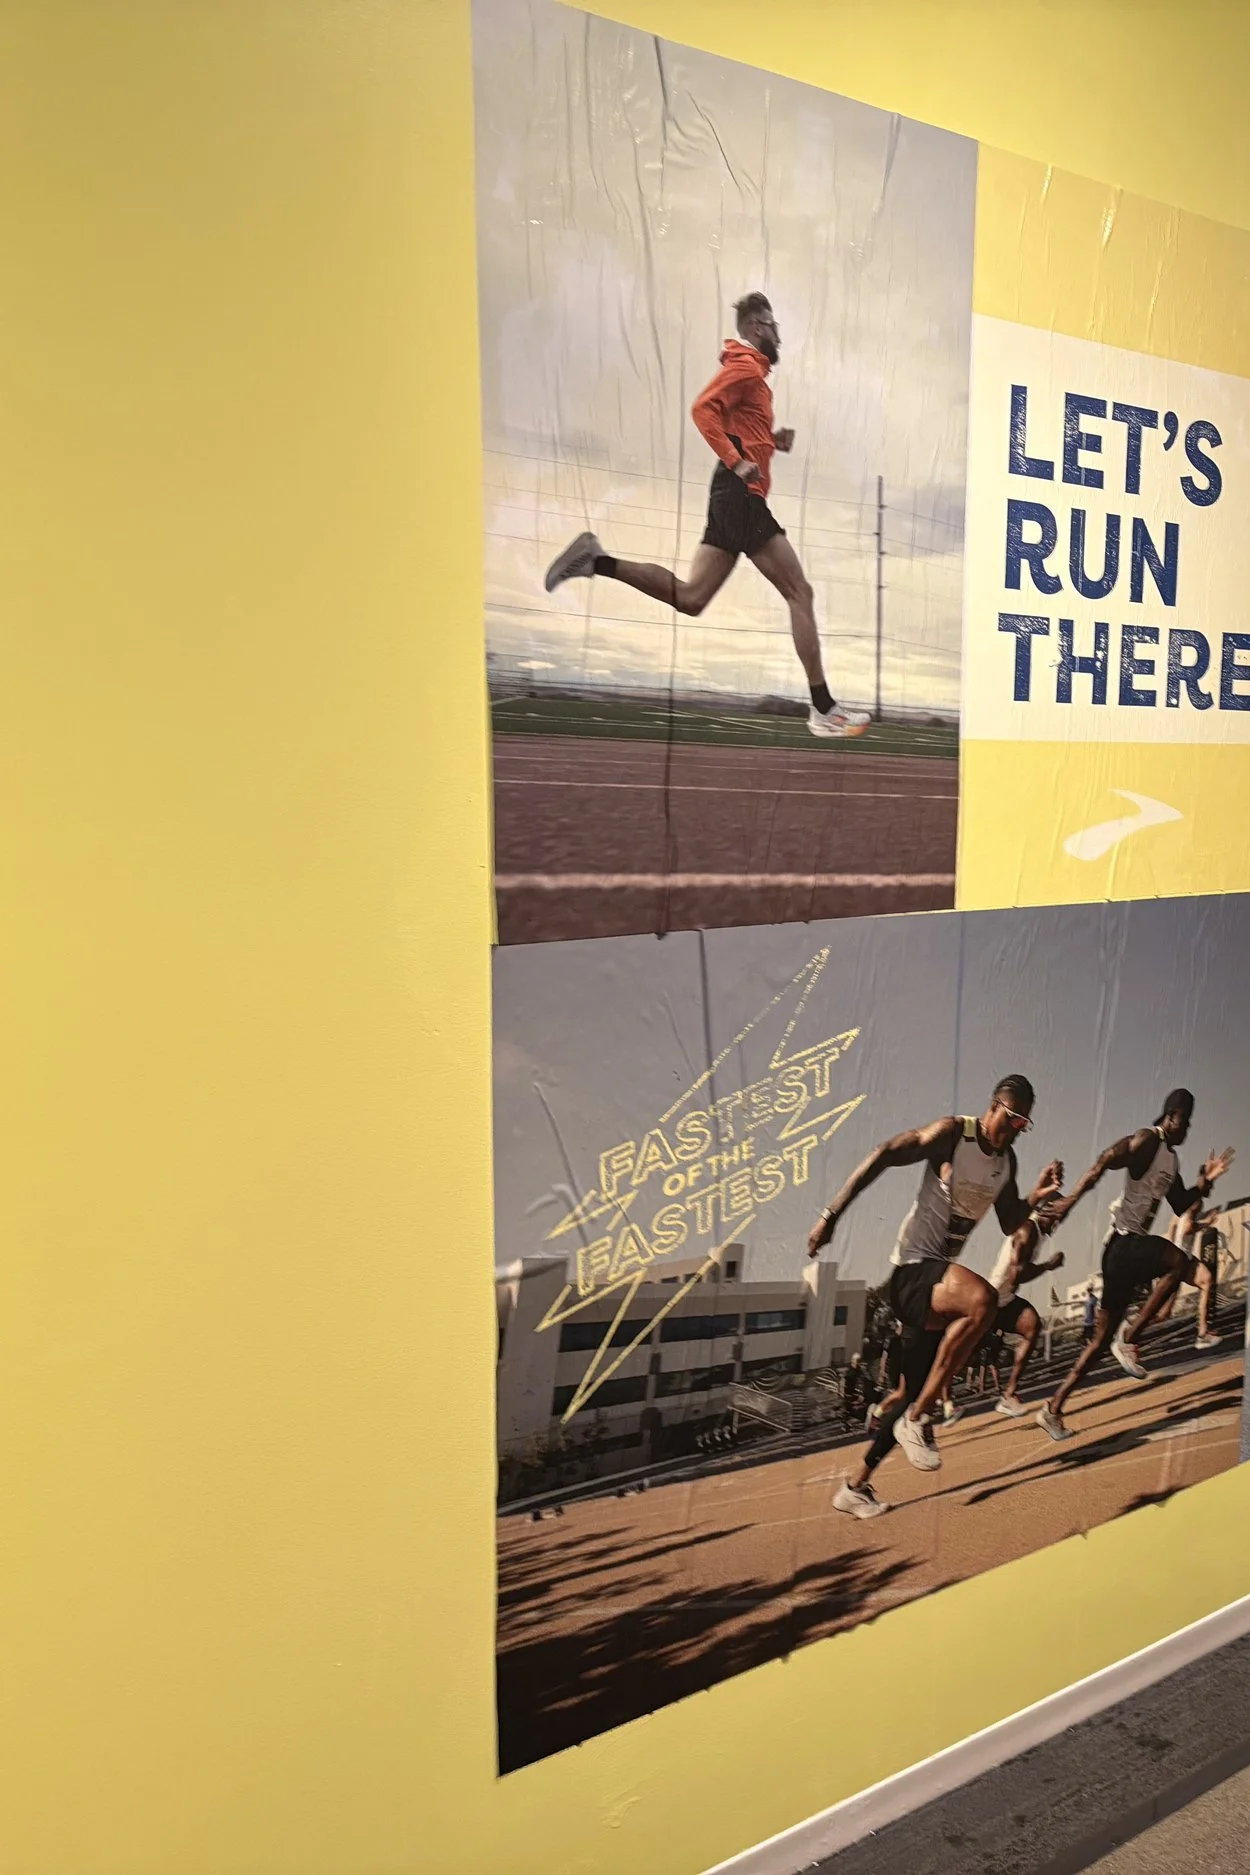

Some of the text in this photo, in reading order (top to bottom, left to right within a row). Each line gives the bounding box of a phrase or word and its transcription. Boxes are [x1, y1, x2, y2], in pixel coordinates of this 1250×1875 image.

[1008, 384, 1223, 507] LET'S
[1005, 498, 1180, 607] RUN
[599, 1047, 840, 1201] FASTEST
[662, 1136, 756, 1196] OF THE
[575, 1134, 818, 1297] FASTEST
